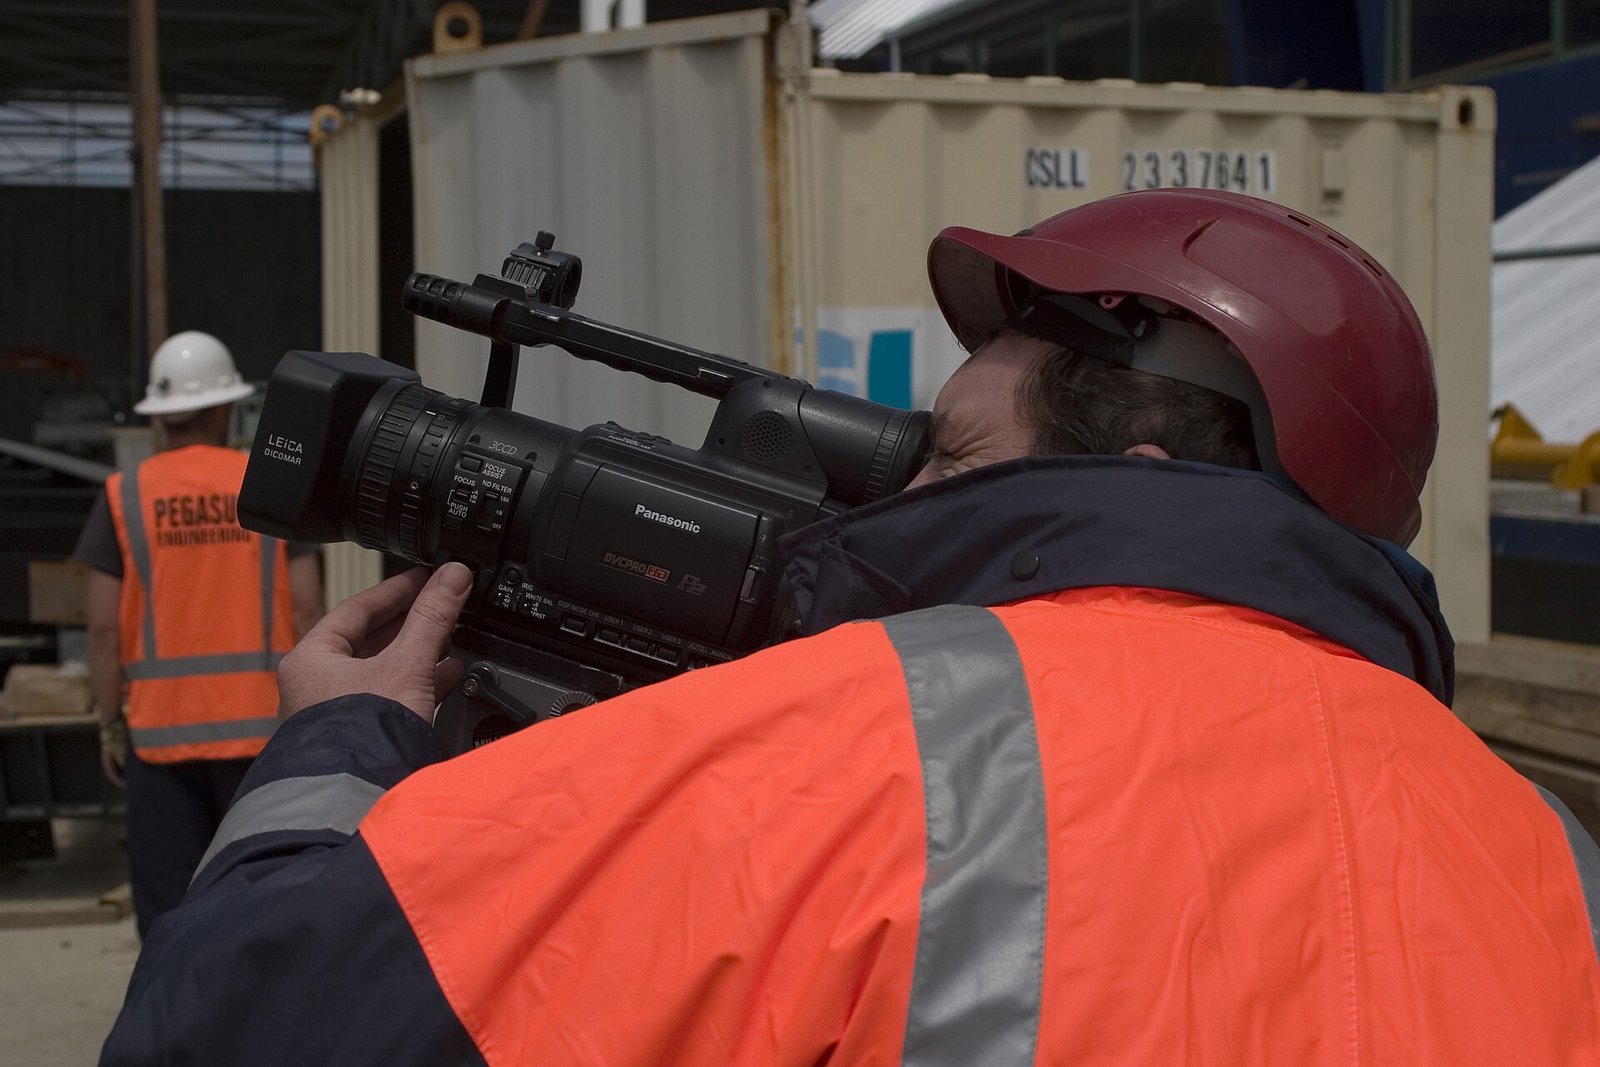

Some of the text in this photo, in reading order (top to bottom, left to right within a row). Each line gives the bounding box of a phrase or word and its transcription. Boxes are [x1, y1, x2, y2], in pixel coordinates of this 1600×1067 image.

[1026, 149, 1086, 188] CSLL
[489, 440, 518, 455] 3CCD
[263, 447, 302, 466] DICOMAR
[481, 469, 505, 480] ASSIST
[484, 462, 506, 475] FOCUS
[454, 474, 477, 487] FOCUS
[492, 482, 513, 494] FILTER
[155, 493, 237, 529] PEGASU
[448, 508, 467, 518] AUTO
[450, 502, 469, 512] PUSH
[635, 503, 701, 534] Panasonic
[498, 584, 513, 594] GAIN
[525, 592, 554, 606] WHITE BAL
[632, 623, 648, 634] USER
[661, 633, 677, 643] USER
